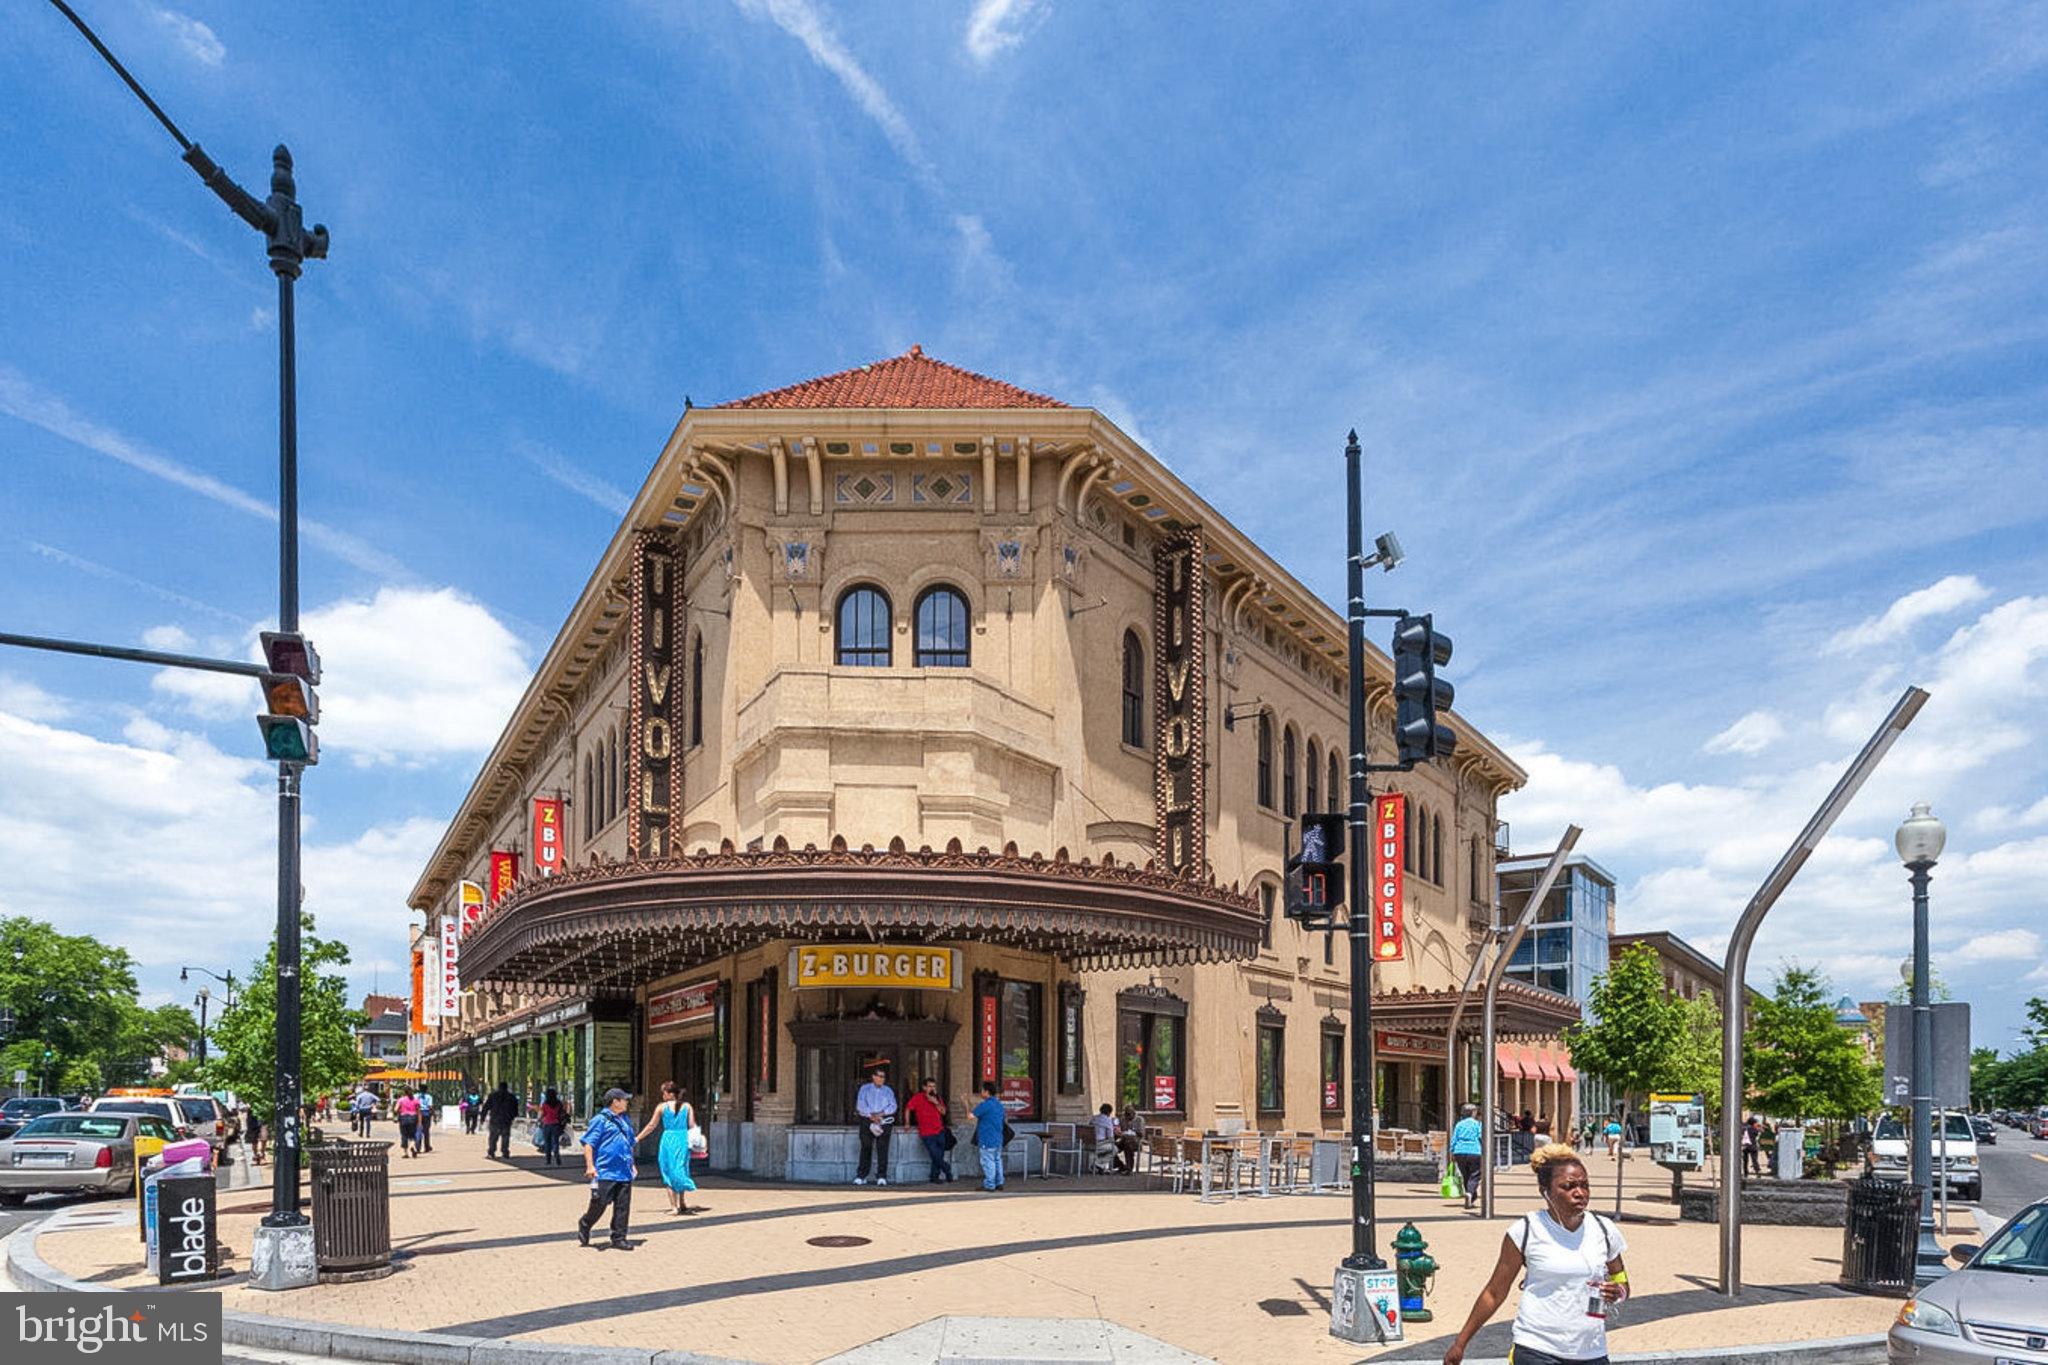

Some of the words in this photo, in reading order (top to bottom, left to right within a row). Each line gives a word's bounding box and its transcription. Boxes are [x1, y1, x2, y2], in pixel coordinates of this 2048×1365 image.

[643, 554, 672, 857] TIVOLI
[1164, 552, 1191, 867] TIVOLI
[544, 808, 555, 823] Z
[1384, 803, 1395, 819] Z
[1382, 823, 1396, 937] BURGER
[803, 954, 945, 978] Z-BURGER
[170, 1197, 206, 1277] blade
